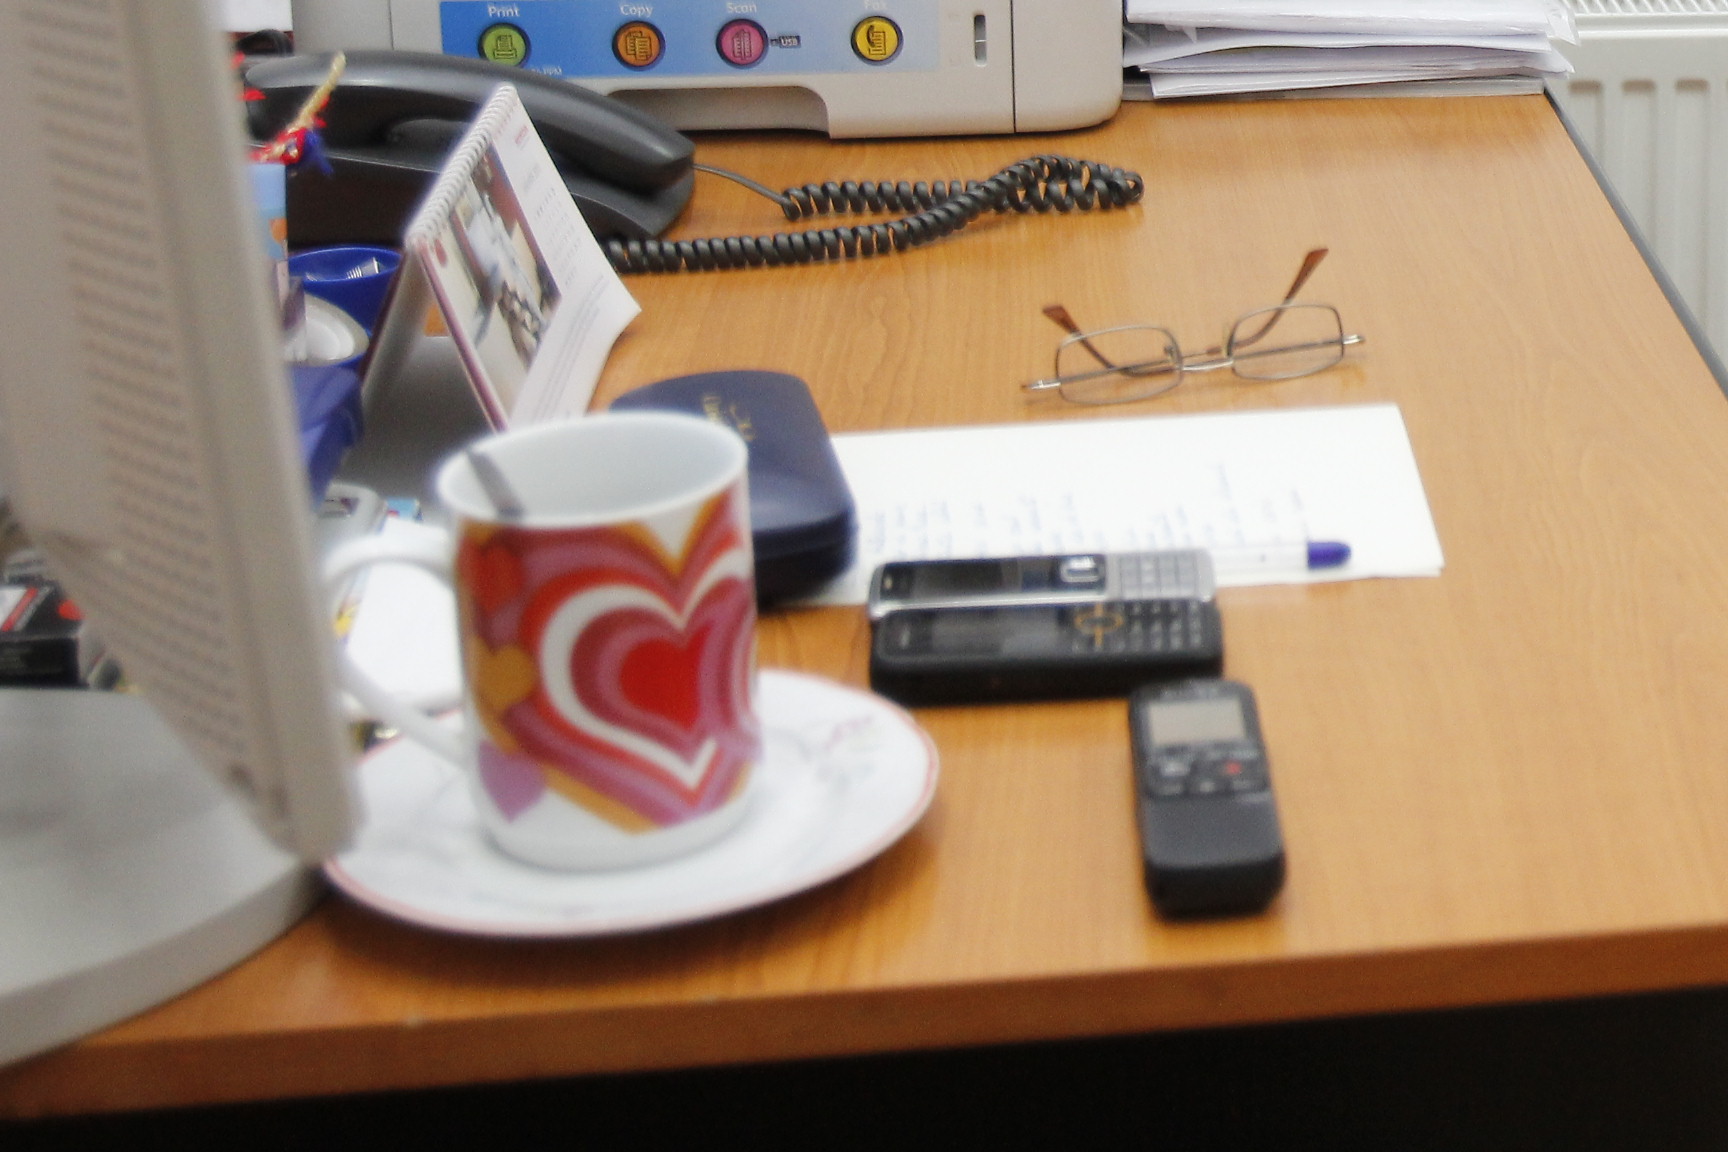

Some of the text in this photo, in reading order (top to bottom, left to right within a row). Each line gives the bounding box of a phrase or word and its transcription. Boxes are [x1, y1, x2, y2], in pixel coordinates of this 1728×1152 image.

[487, 4, 521, 18] Print
[619, 4, 654, 19] Copy
[726, 2, 758, 14] Scan
[780, 37, 798, 47] USB
